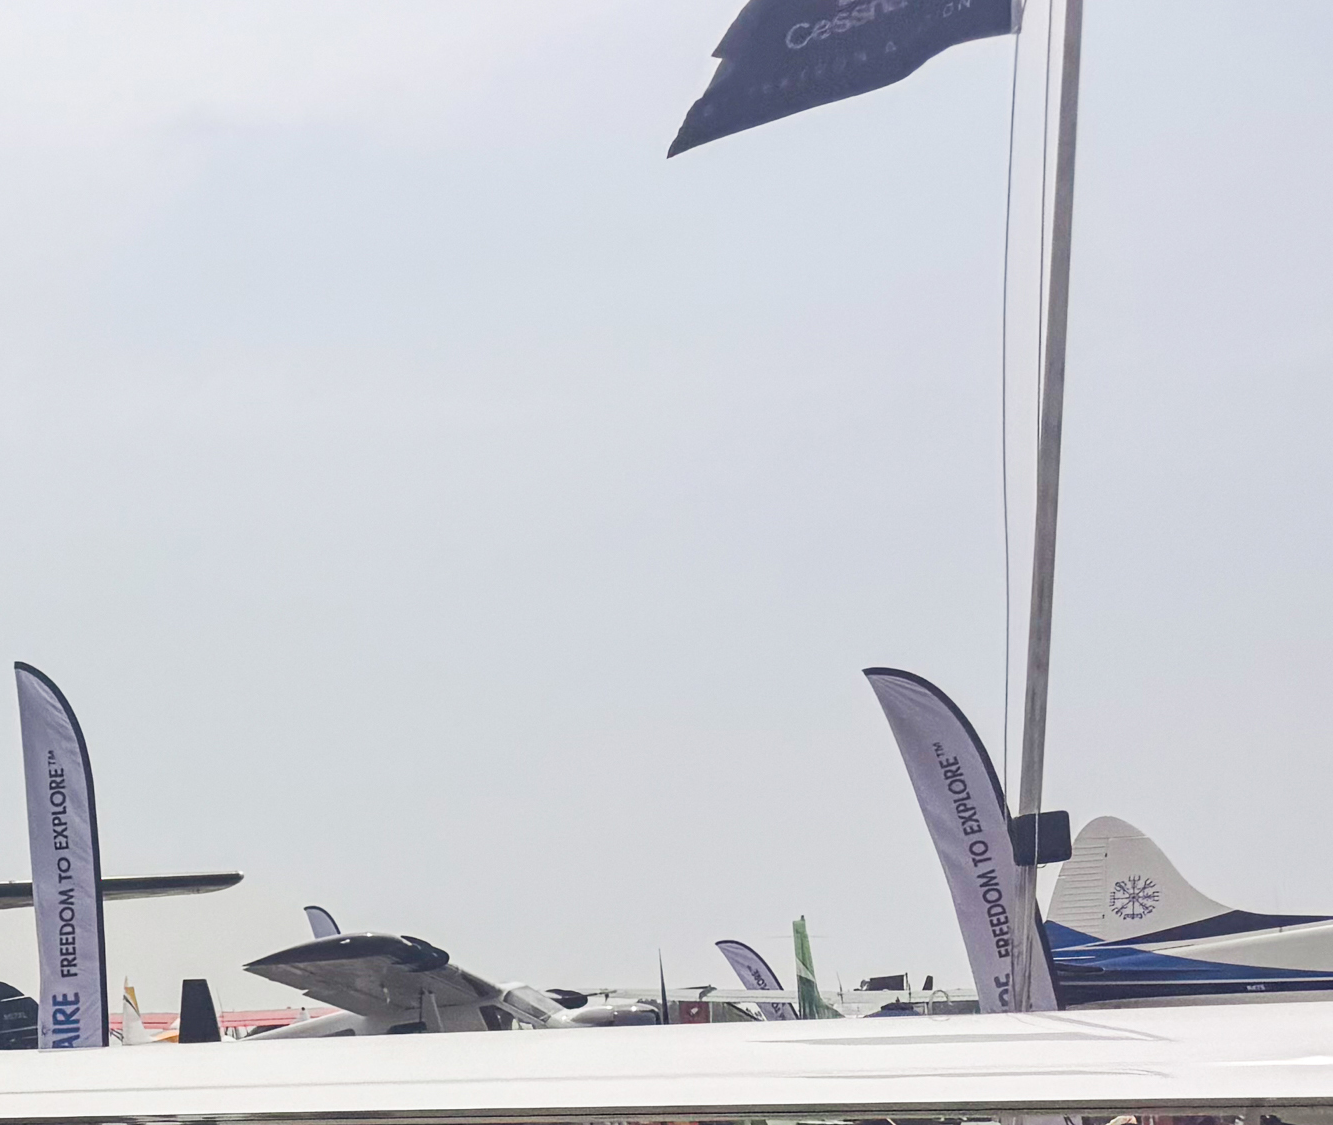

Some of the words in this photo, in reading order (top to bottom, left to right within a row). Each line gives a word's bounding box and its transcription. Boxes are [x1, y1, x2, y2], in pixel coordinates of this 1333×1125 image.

[969, 839, 992, 867] TO
[57, 856, 74, 884] TO
[59, 888, 78, 978] FREEDOM
